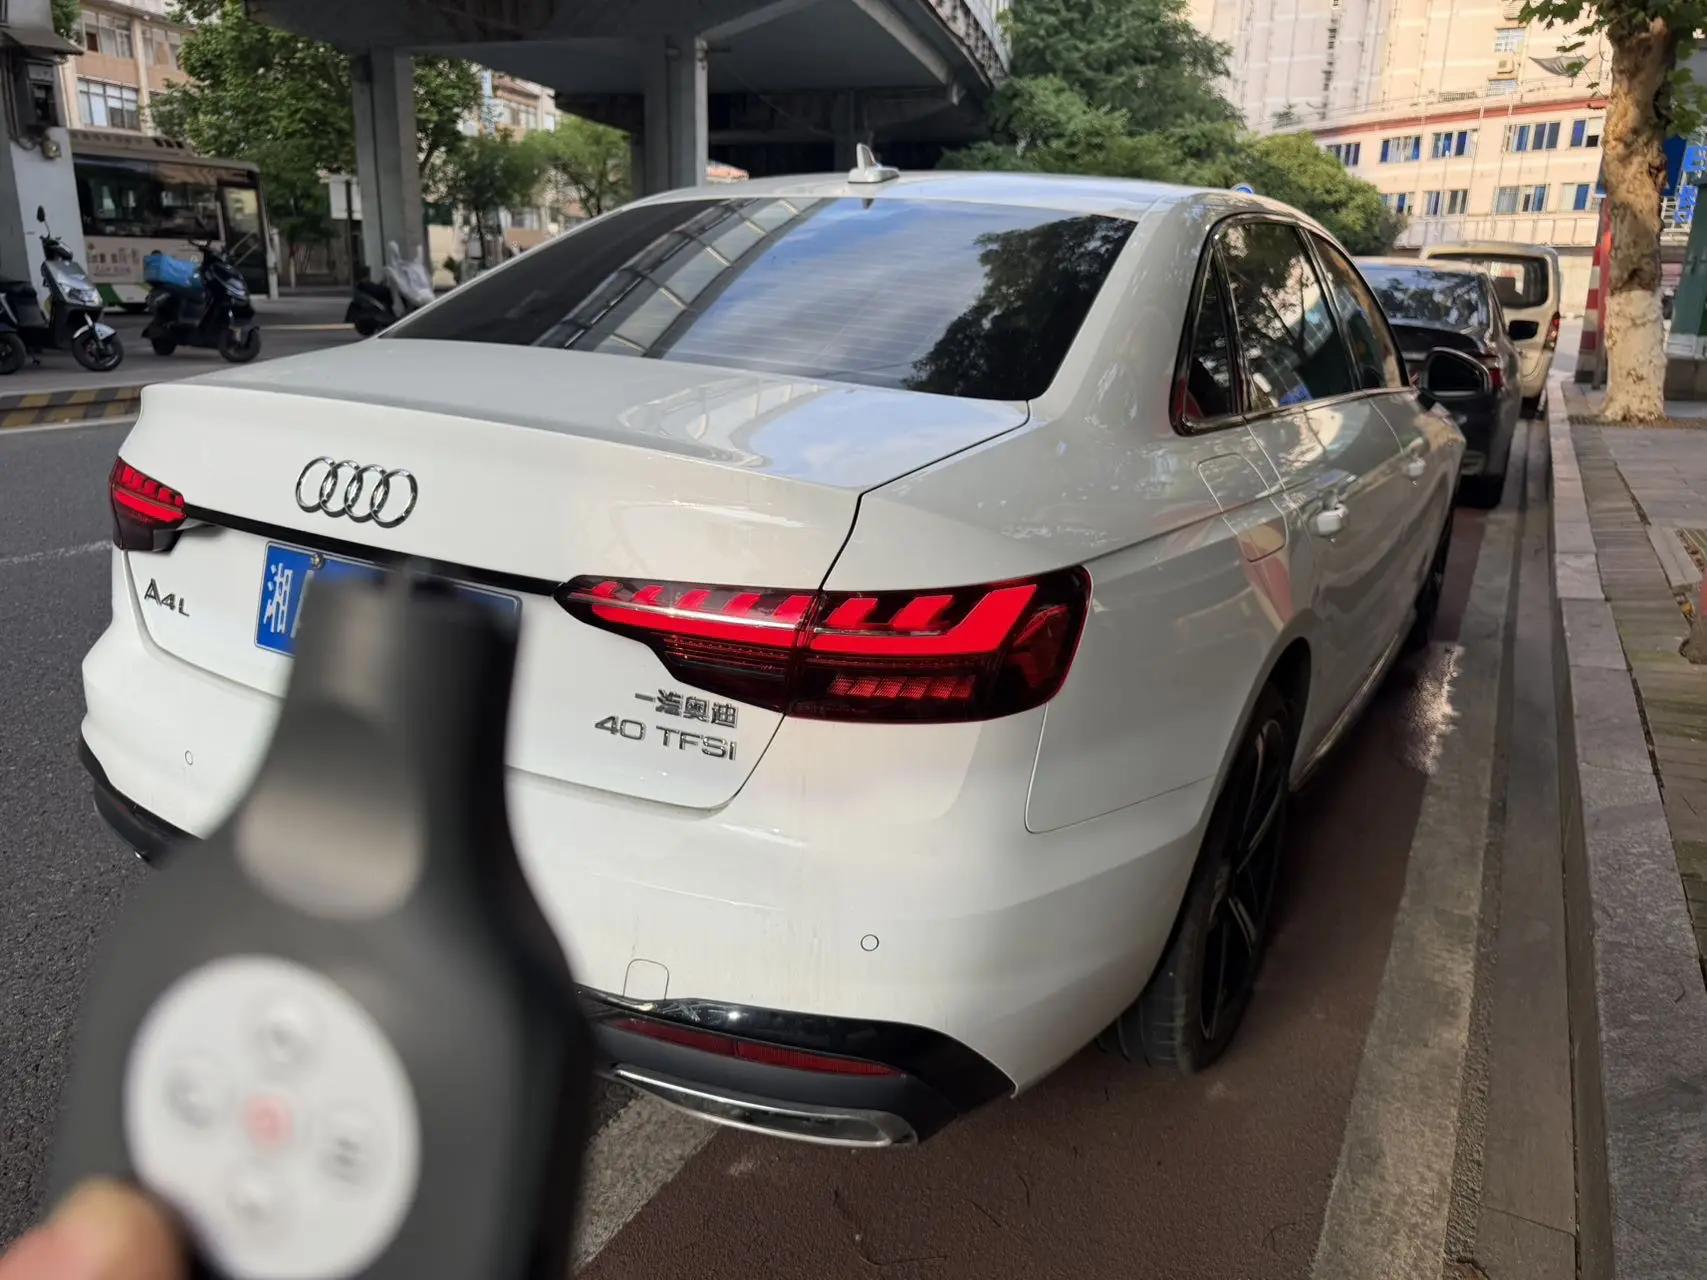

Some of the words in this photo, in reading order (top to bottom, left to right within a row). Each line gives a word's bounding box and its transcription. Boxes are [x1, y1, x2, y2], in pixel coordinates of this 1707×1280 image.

[144, 577, 190, 617] A4L
[634, 689, 738, 728] 一汽奥迪
[595, 715, 646, 740] 40
[655, 725, 737, 760] TFSI
